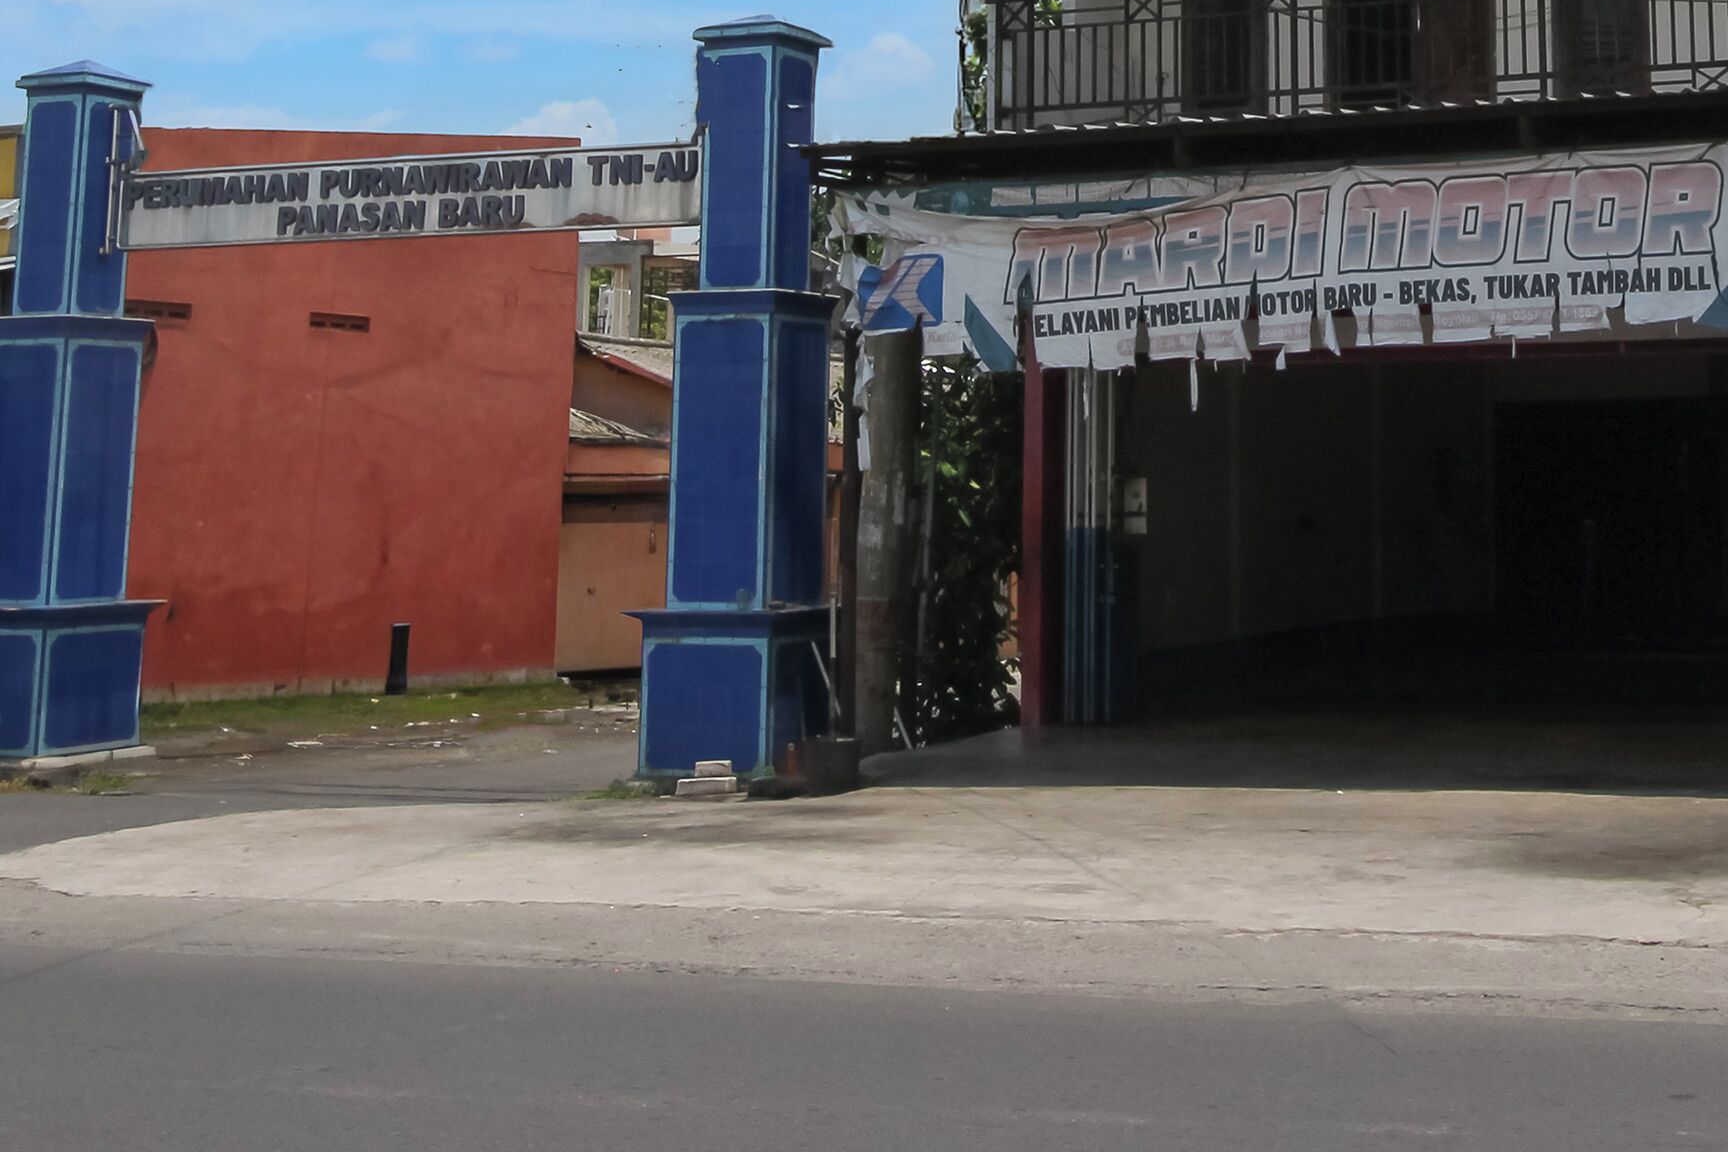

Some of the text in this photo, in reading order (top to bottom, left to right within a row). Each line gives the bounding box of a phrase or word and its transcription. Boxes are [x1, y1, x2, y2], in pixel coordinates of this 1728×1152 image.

[124, 150, 699, 211] PERUMAHAN PURNAWIRAWAN TNI-AU
[277, 195, 525, 236] PANASAN BARU
[1003, 158, 1724, 304] MARDI MOTOR
[1012, 307, 1120, 338] ELAYANI
[1324, 282, 1377, 311] BARU
[1400, 277, 1477, 305] BEKAS,
[1483, 272, 1561, 300] TUKAR
[1567, 268, 1661, 295] TAMBAH
[1668, 266, 1712, 291] DLL
